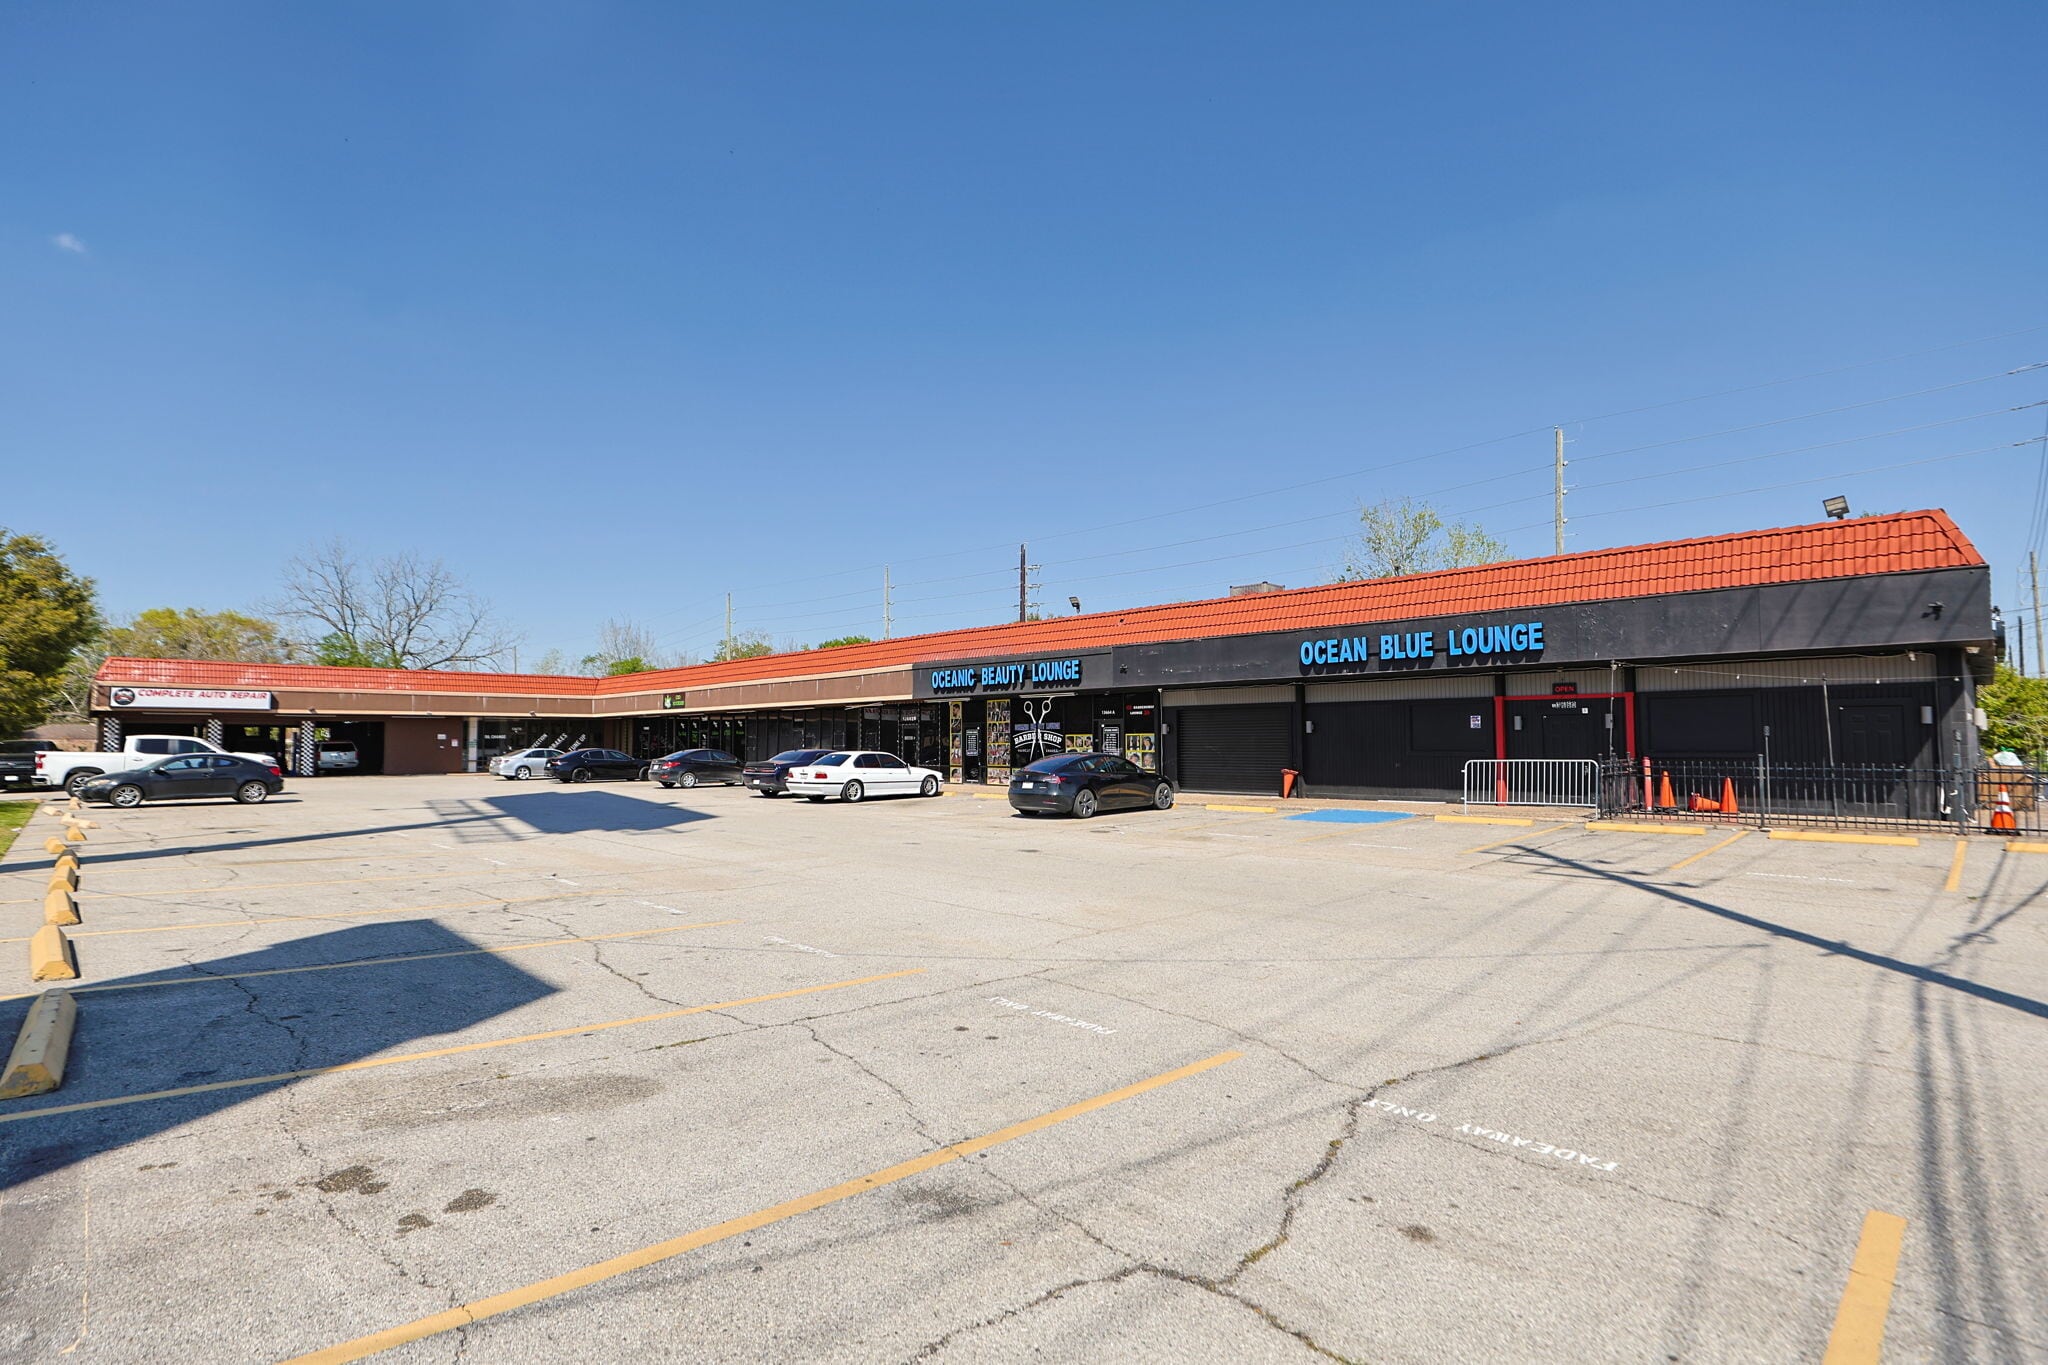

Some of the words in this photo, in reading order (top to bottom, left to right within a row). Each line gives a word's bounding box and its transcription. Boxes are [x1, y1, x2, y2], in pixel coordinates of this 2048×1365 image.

[1300, 637, 1367, 665] OCEAN
[1380, 631, 1434, 660] BLUE
[1448, 622, 1544, 656] LOUNGE
[932, 668, 975, 688] OCEANIC
[981, 664, 1025, 686] BEAUTY
[1032, 659, 1079, 682] LOUNGE
[138, 689, 194, 698] COMPLETE
[199, 690, 226, 699] AUTO
[230, 691, 268, 699] REPAIR
[1043, 733, 1063, 744] SHOP
[1362, 1099, 1437, 1122] ONLY
[1454, 1123, 1618, 1172] FADEAWAY
